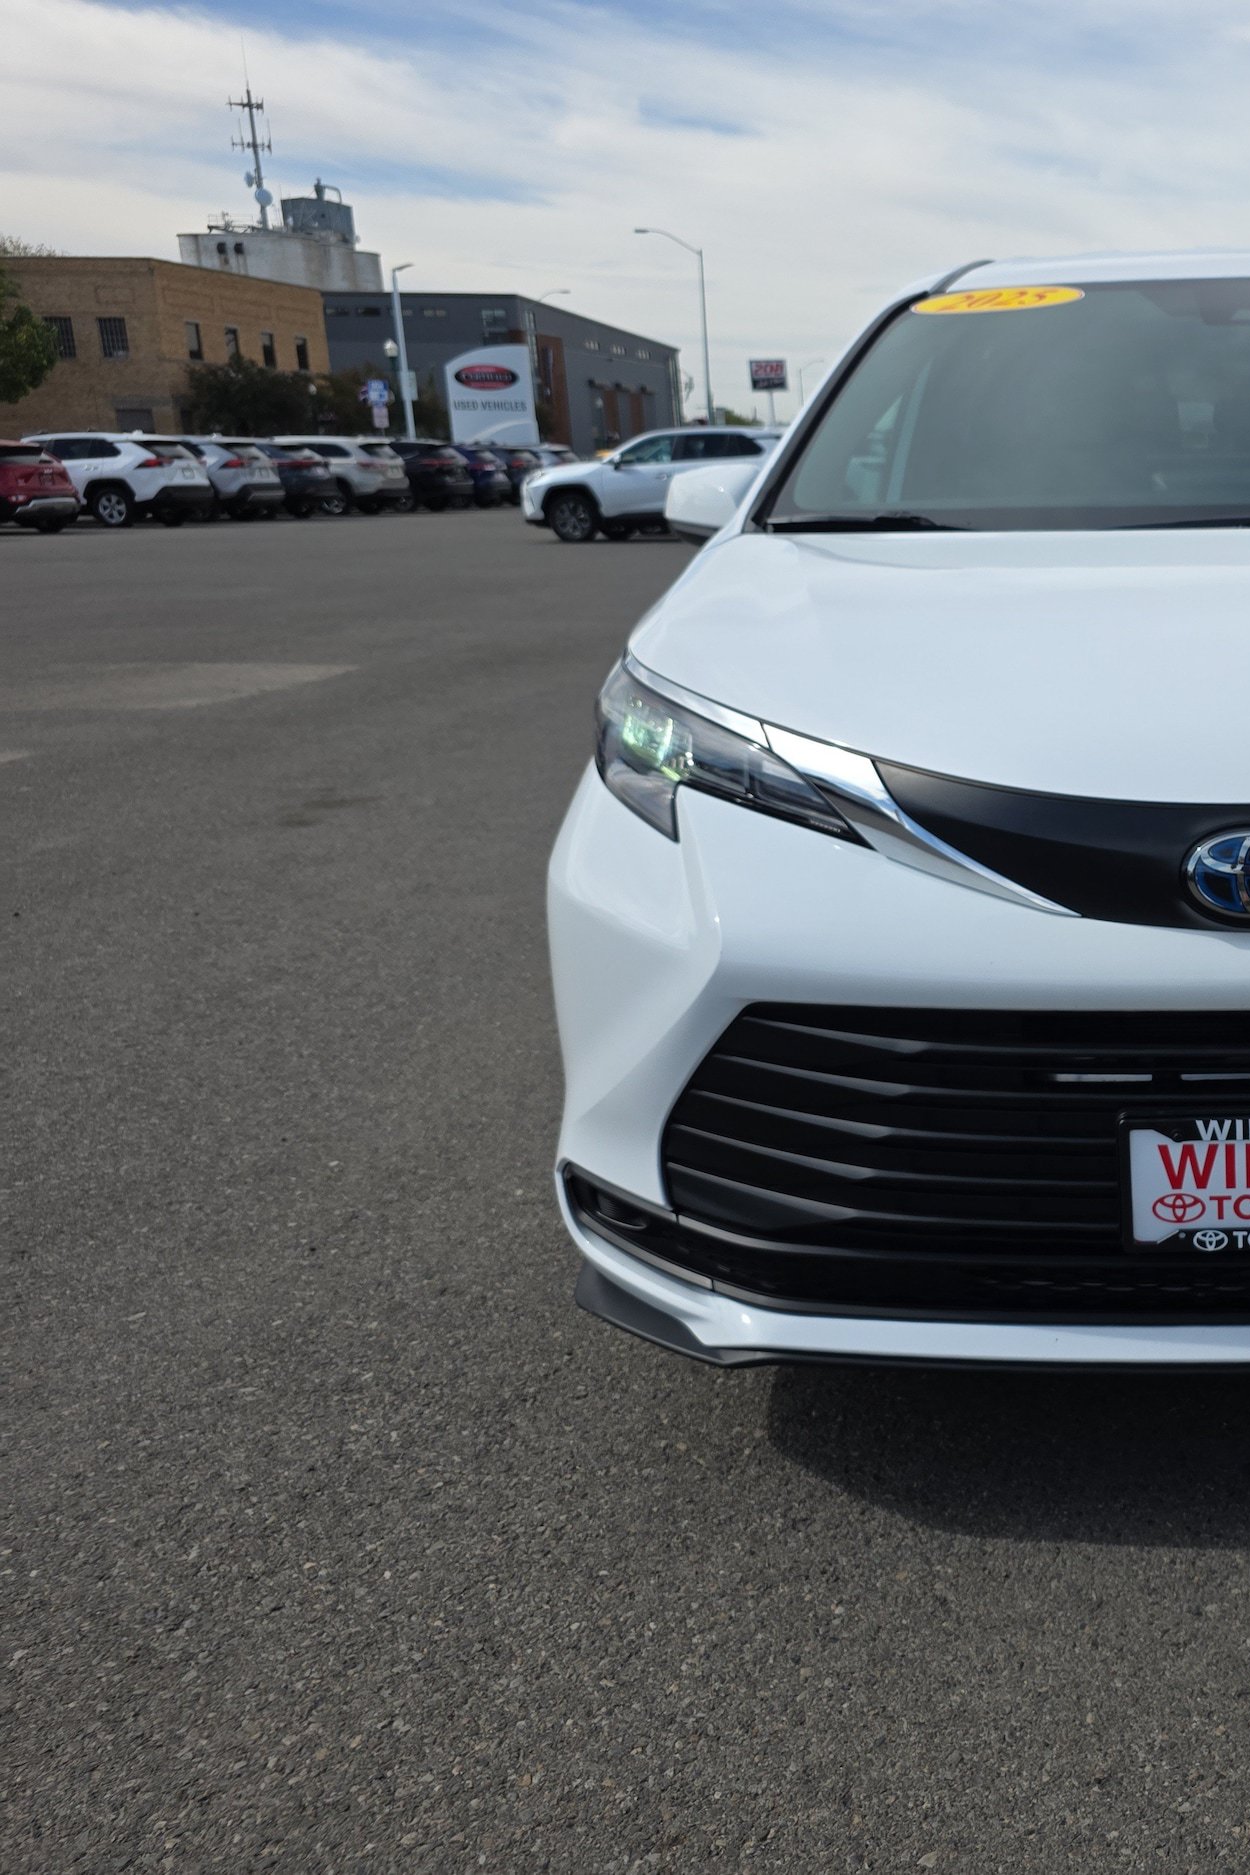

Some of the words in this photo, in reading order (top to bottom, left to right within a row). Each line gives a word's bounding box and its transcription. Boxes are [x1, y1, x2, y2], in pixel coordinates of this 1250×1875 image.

[936, 288, 1058, 312] 2025
[453, 400, 479, 411] USED
[480, 400, 528, 412] VEHICLES
